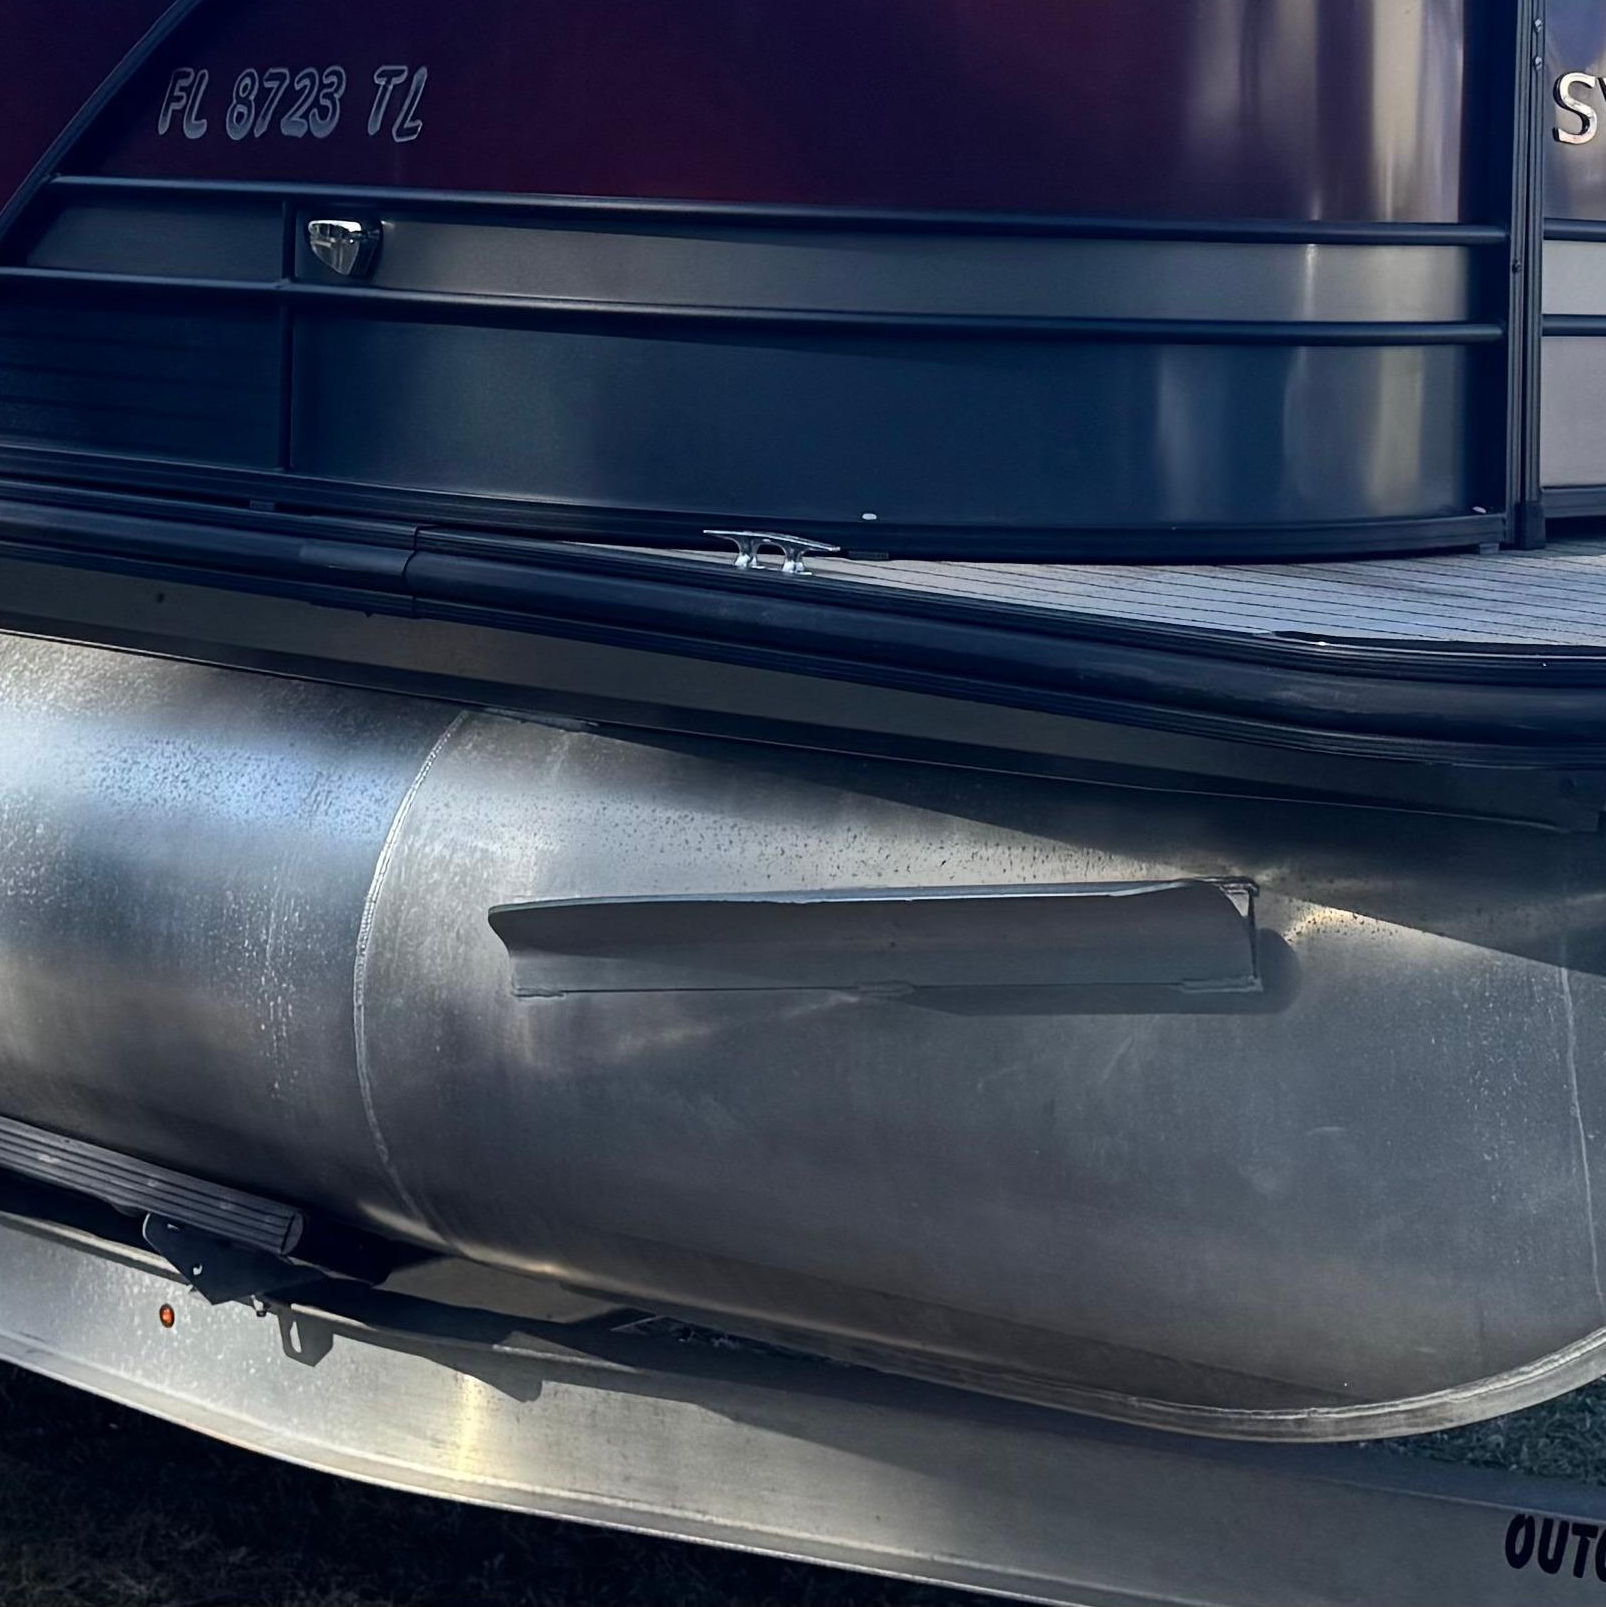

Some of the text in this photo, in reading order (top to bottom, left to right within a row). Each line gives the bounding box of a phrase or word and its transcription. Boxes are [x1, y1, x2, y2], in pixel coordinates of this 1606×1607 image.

[157, 65, 428, 143] FL 8723 TL
